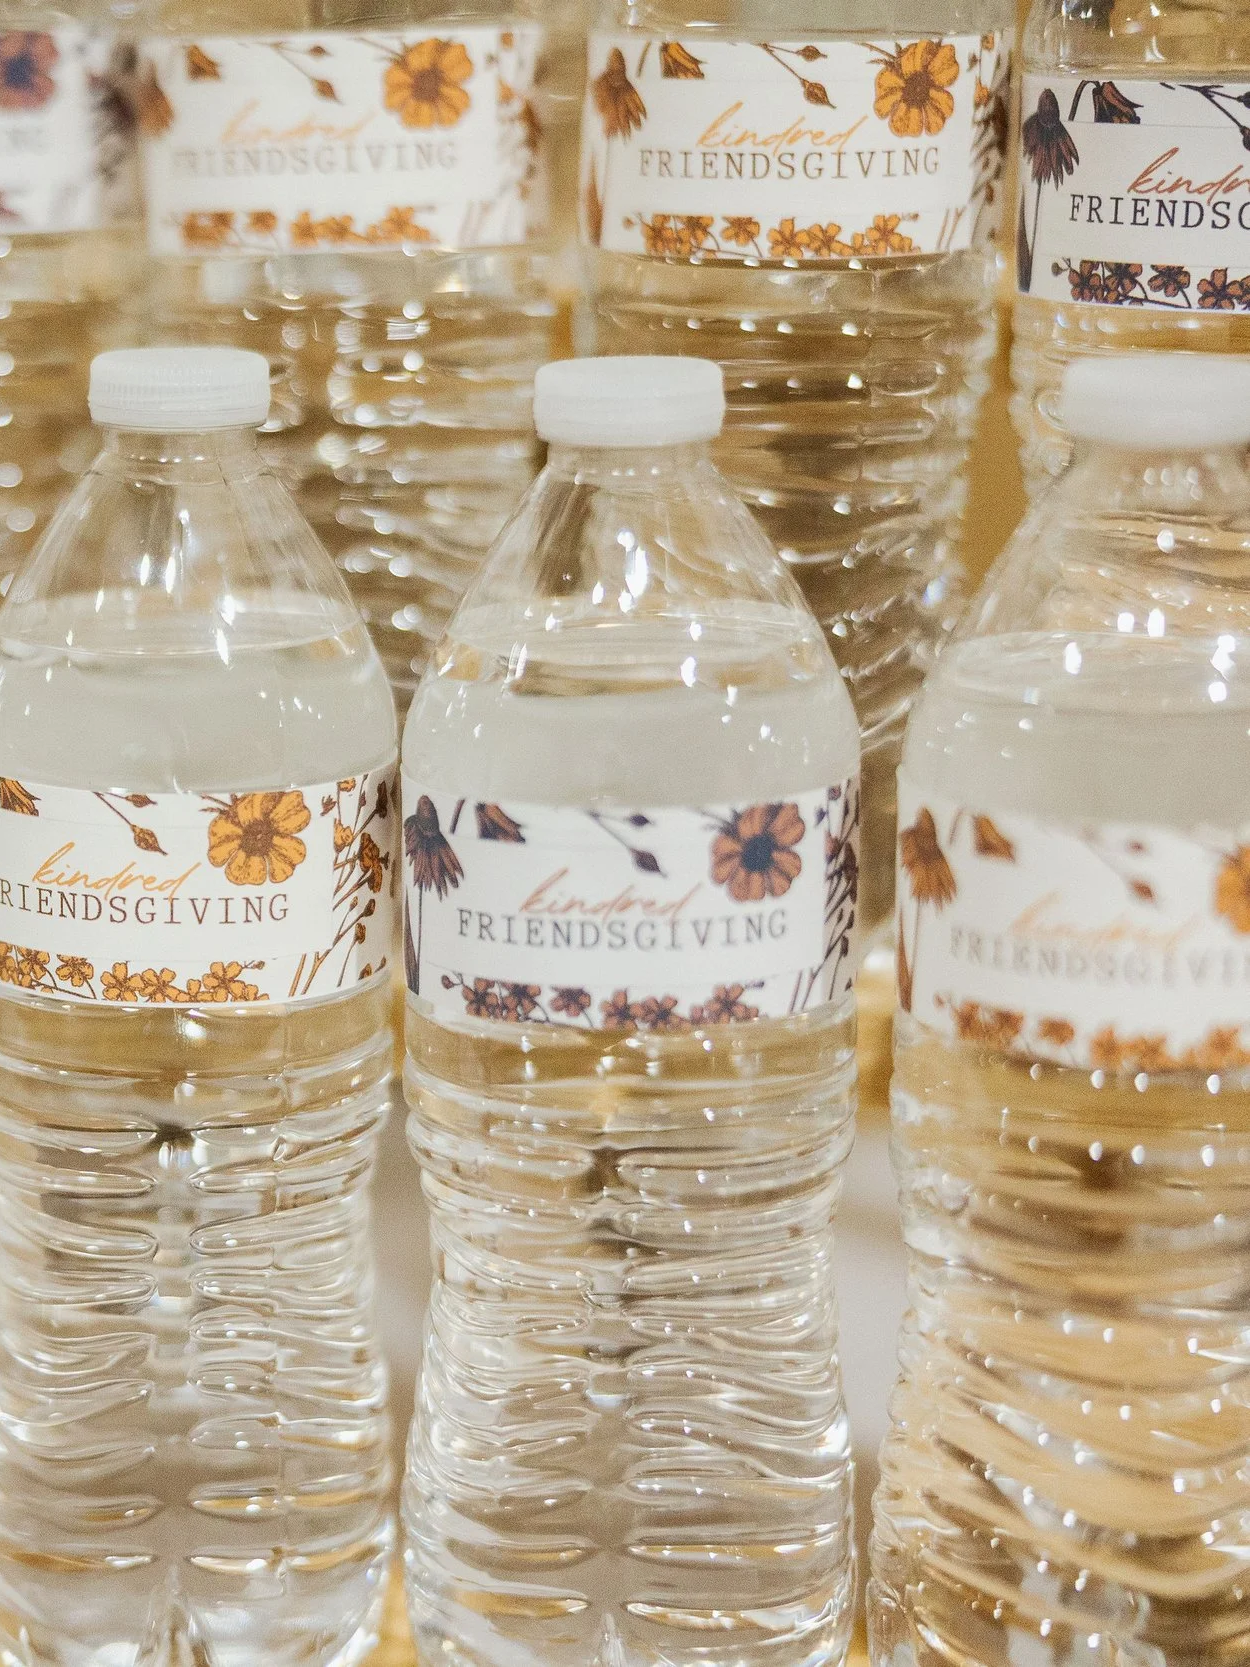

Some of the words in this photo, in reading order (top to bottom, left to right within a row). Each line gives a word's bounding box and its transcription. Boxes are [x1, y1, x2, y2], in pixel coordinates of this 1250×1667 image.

[696, 100, 868, 155] kindred
[639, 147, 939, 180] FRIENDSGIVING
[31, 841, 202, 902] kindred
[518, 867, 703, 926] kindred
[456, 907, 788, 951] FRIENDSGIVING
